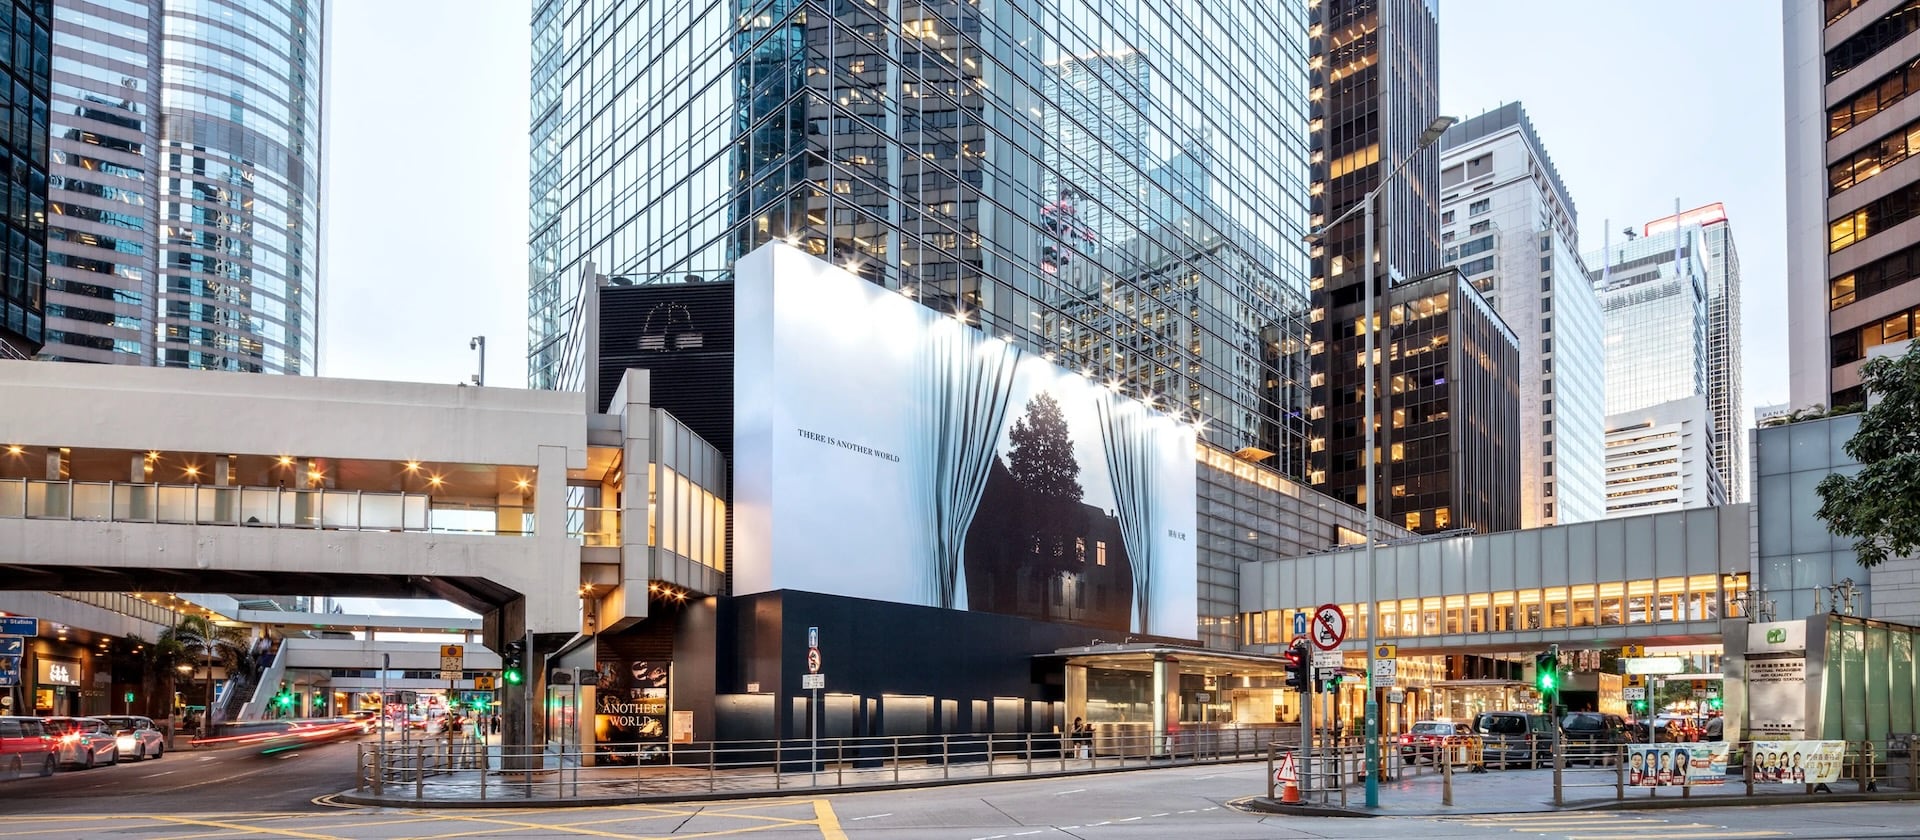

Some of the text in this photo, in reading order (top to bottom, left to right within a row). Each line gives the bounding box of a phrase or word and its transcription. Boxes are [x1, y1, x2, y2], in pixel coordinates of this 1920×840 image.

[797, 428, 900, 463] THERE IS ANOTHER WORLD
[602, 703, 659, 714] ANOTHER
[609, 715, 652, 727] WORLD
[1817, 762, 1831, 778] 27
